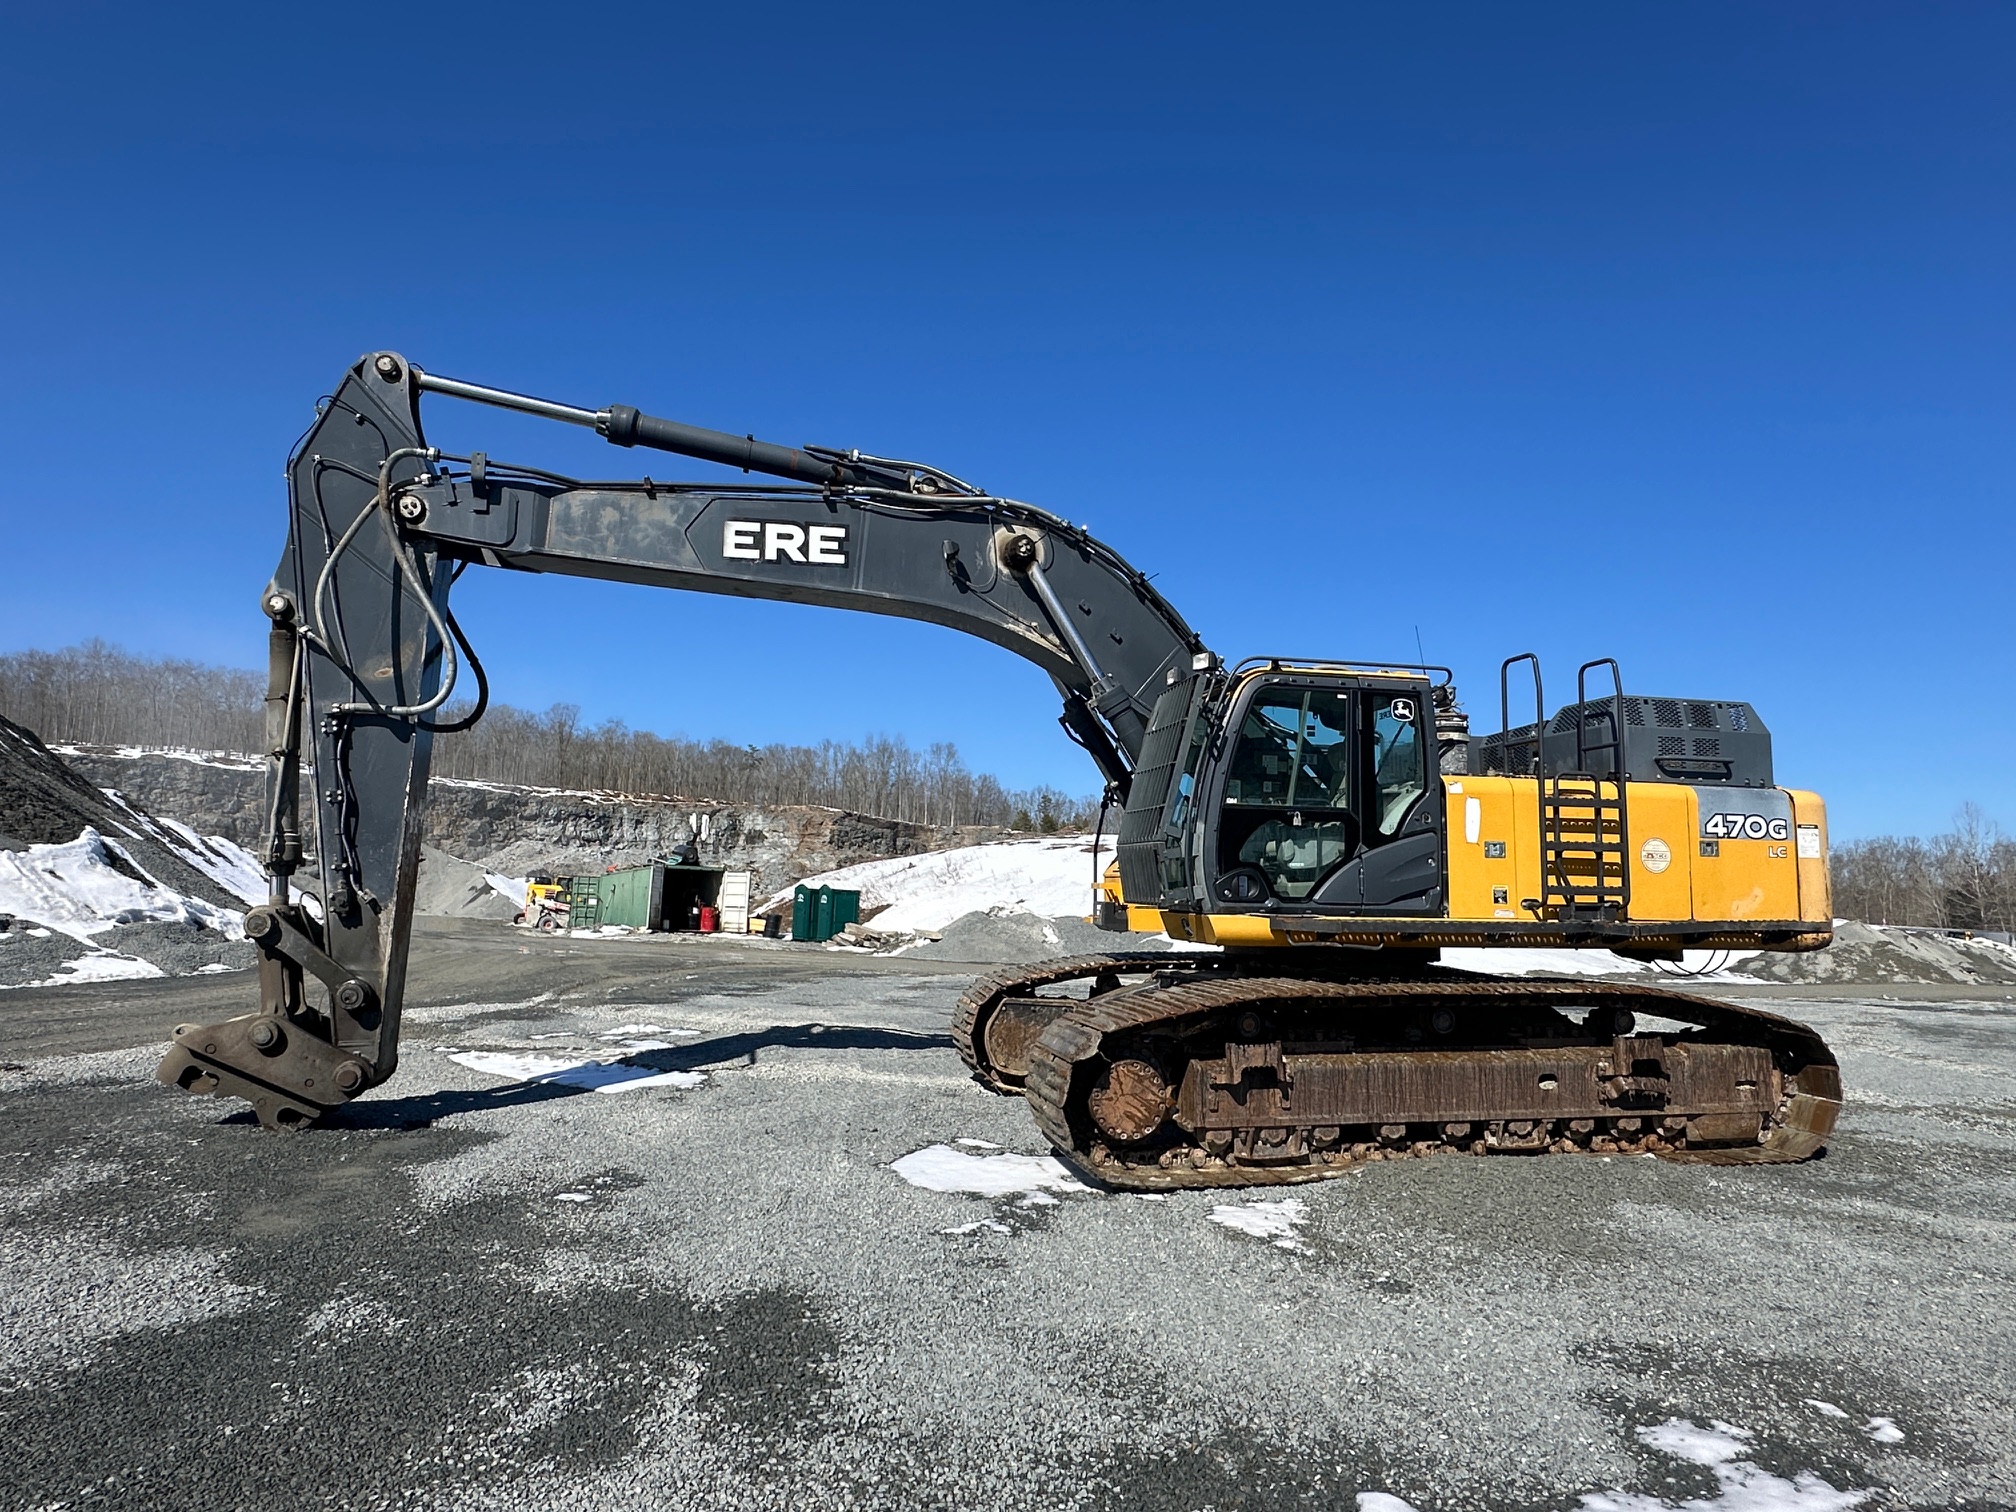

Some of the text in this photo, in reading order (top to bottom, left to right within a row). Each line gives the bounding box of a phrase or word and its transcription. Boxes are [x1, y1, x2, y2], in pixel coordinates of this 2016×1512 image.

[723, 520, 846, 564] ERE
[1705, 813, 1787, 840] 470G
[1768, 846, 1787, 858] LC
